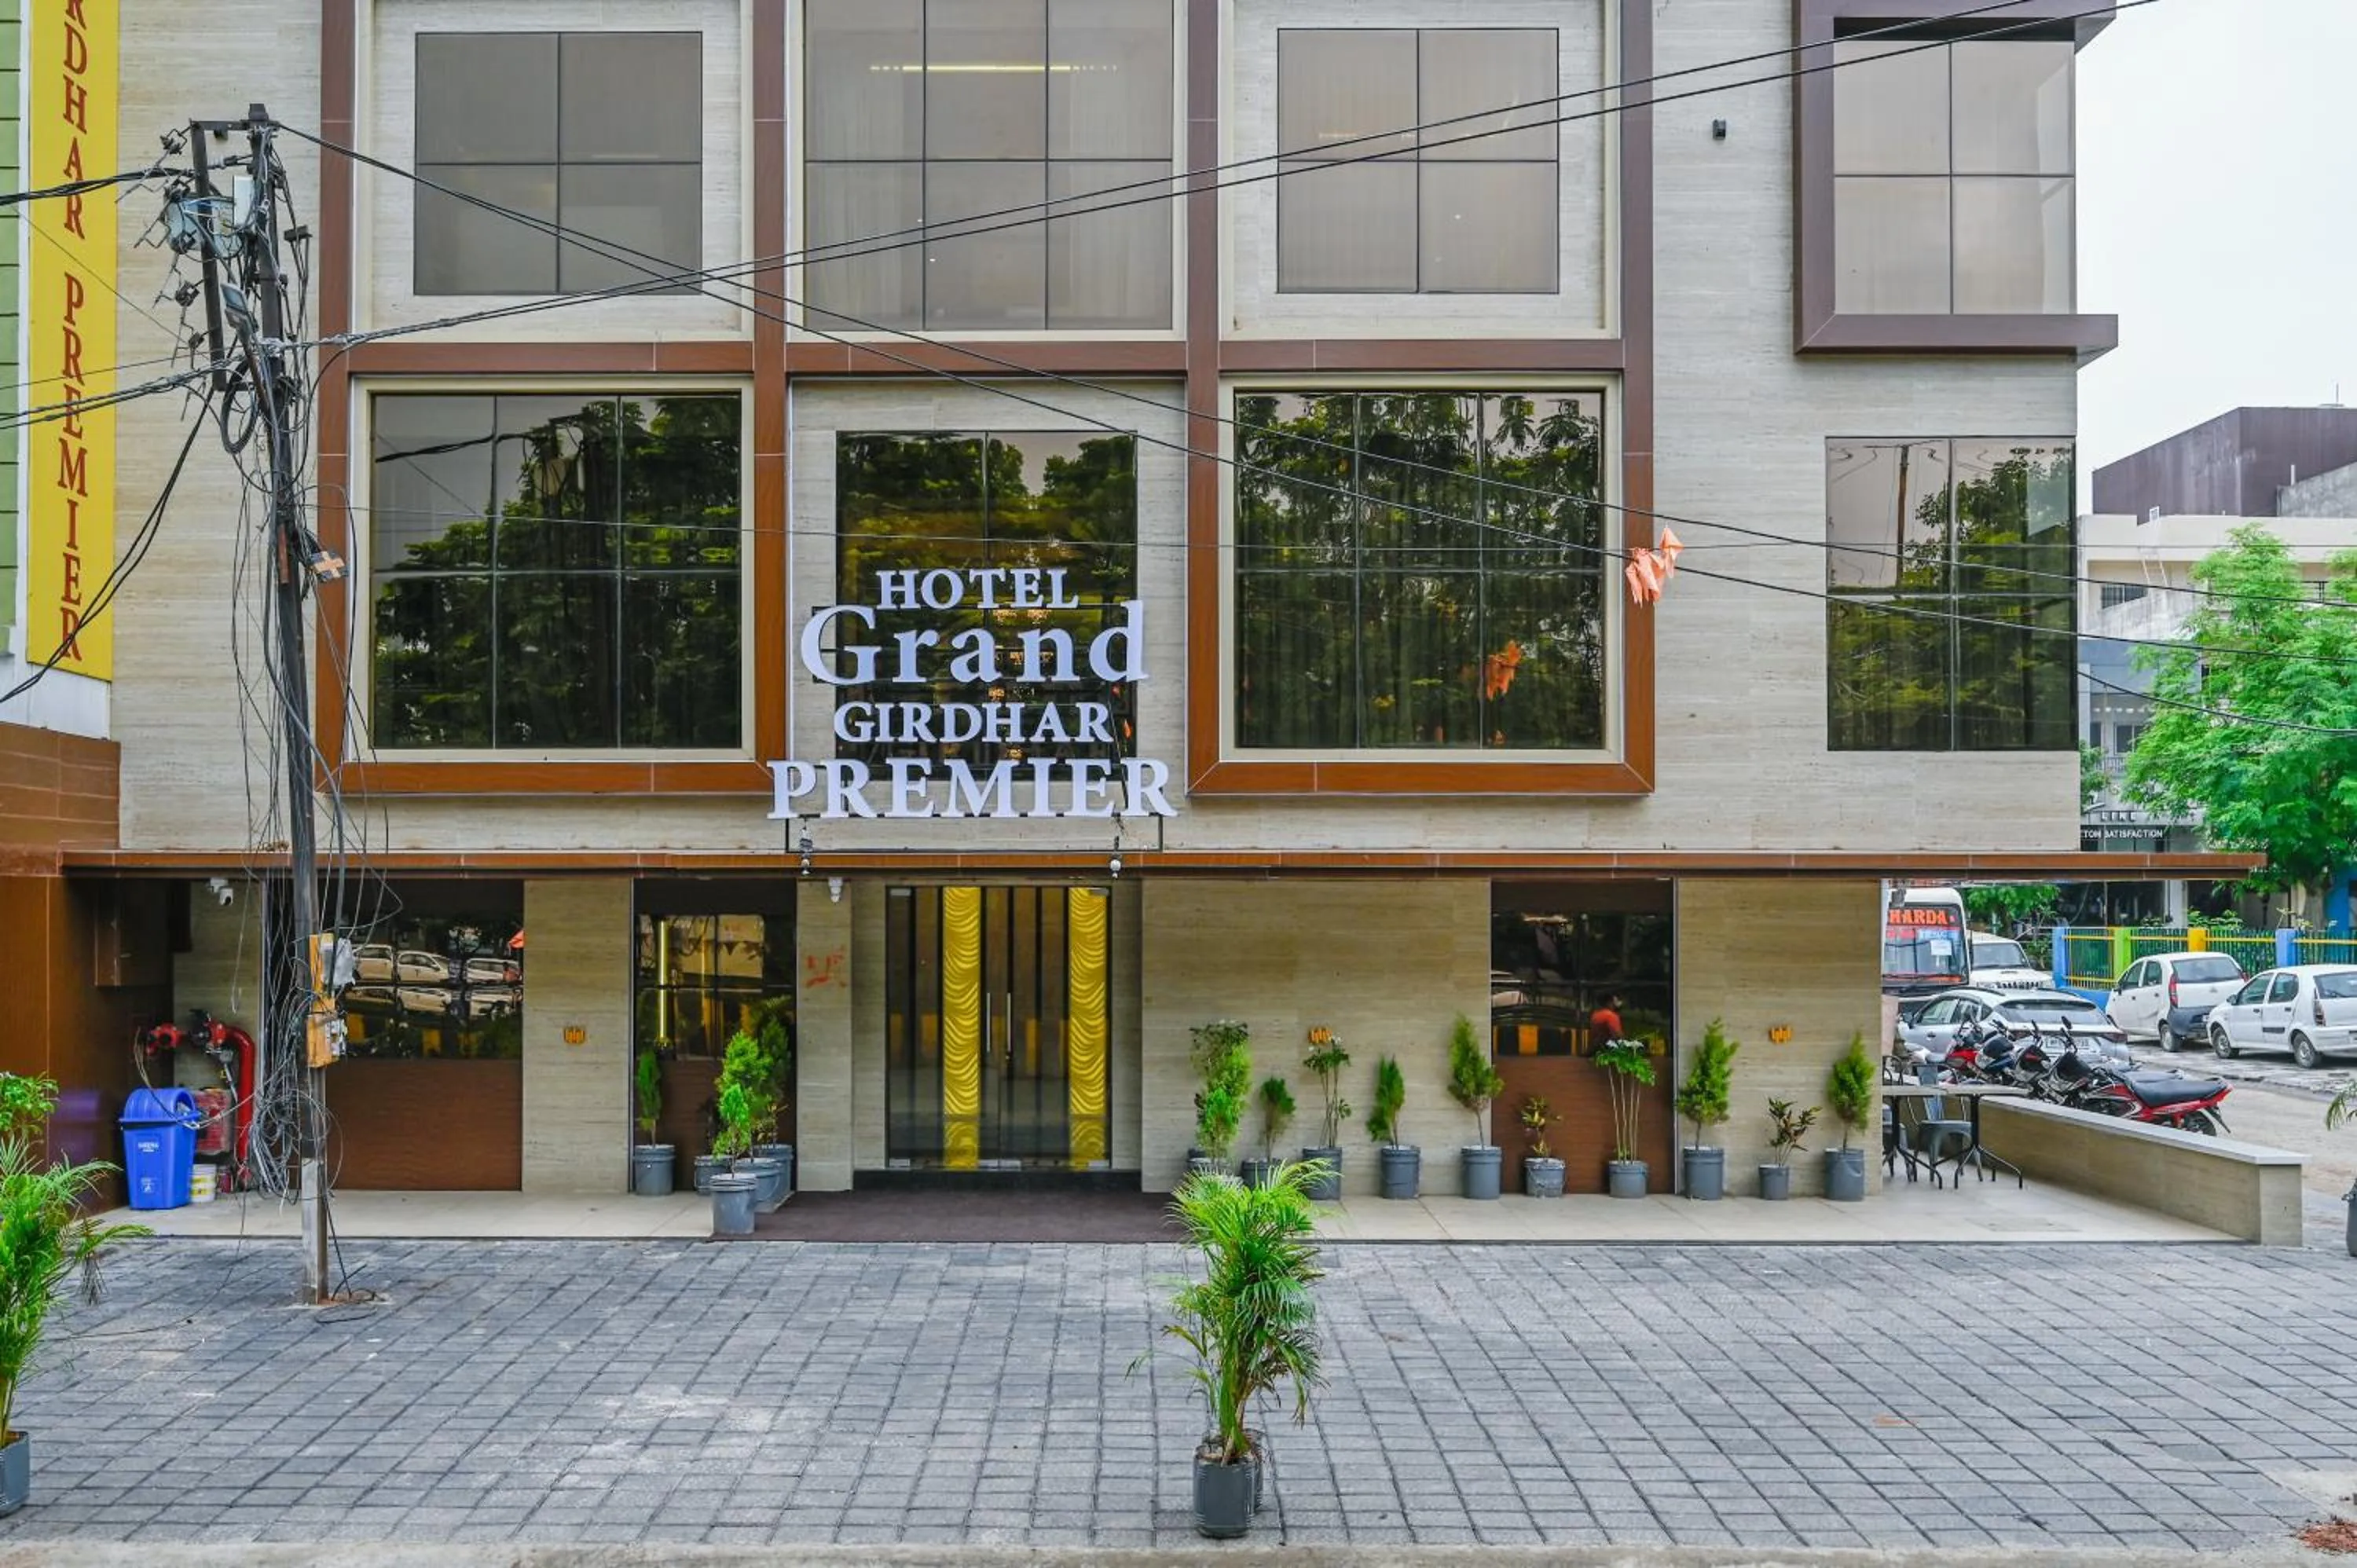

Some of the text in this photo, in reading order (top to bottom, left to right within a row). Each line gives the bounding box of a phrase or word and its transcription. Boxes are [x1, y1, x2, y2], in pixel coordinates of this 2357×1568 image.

[58, 271, 88, 662] PREMIER
[875, 567, 1080, 610] HOTEL
[800, 600, 1149, 686] Grand
[833, 701, 1114, 744] GIRDHAR
[766, 757, 1178, 819] PREMIER
[2105, 829, 2164, 839] SATISFACTION
[1889, 909, 1948, 925] HARDA
